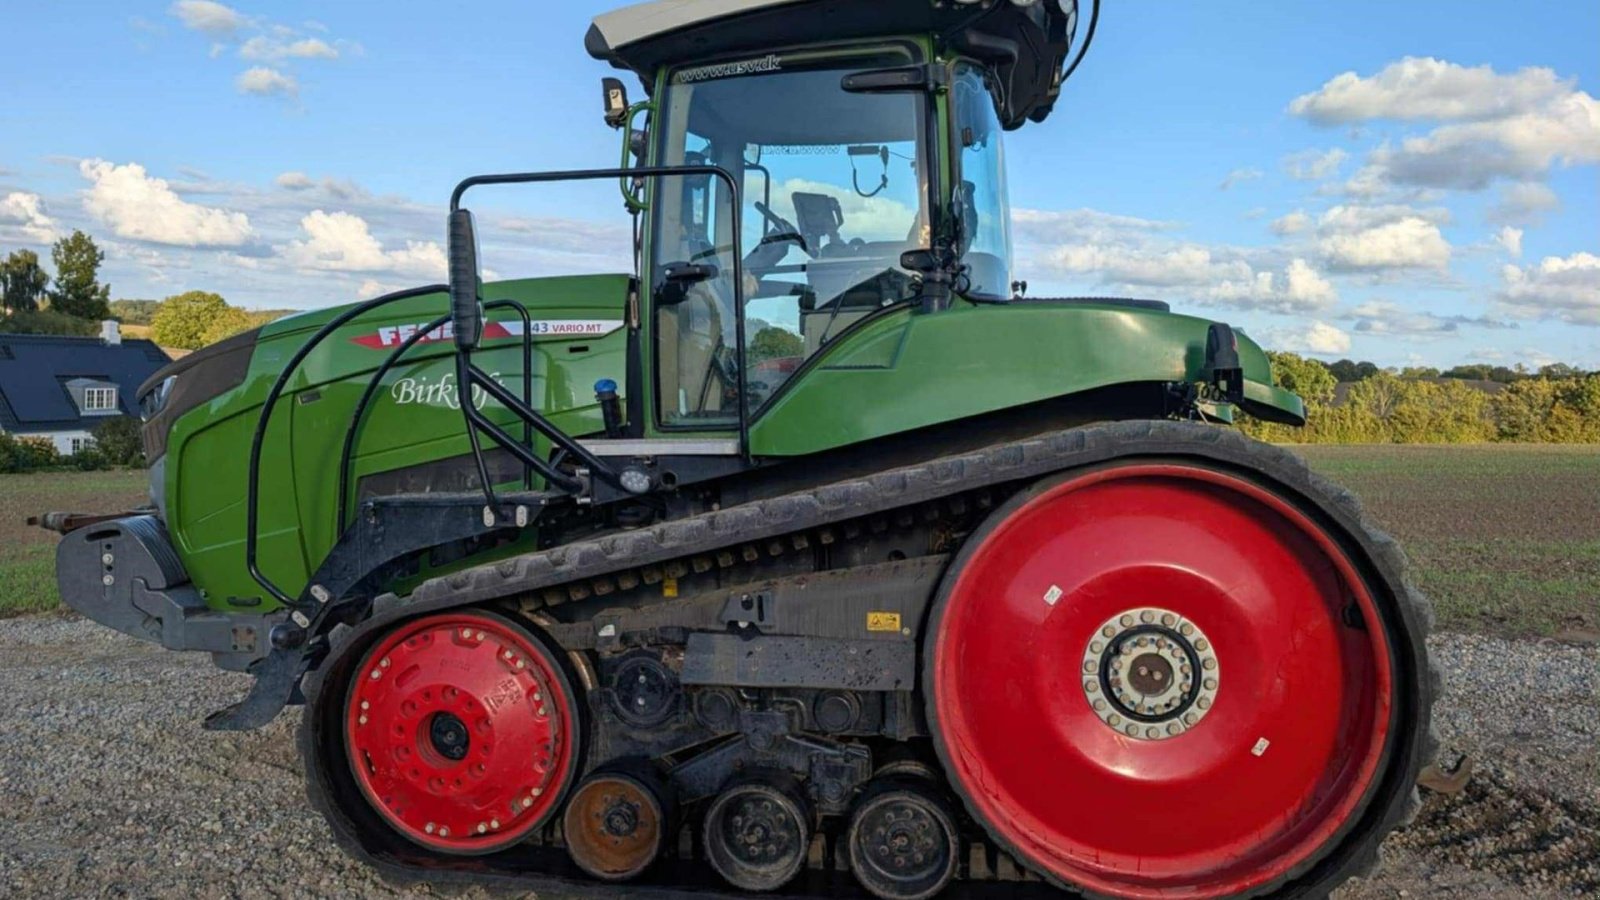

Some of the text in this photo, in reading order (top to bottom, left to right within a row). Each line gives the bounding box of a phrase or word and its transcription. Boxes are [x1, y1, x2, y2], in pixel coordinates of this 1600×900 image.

[532, 322, 602, 333] 43 VARIO MT
